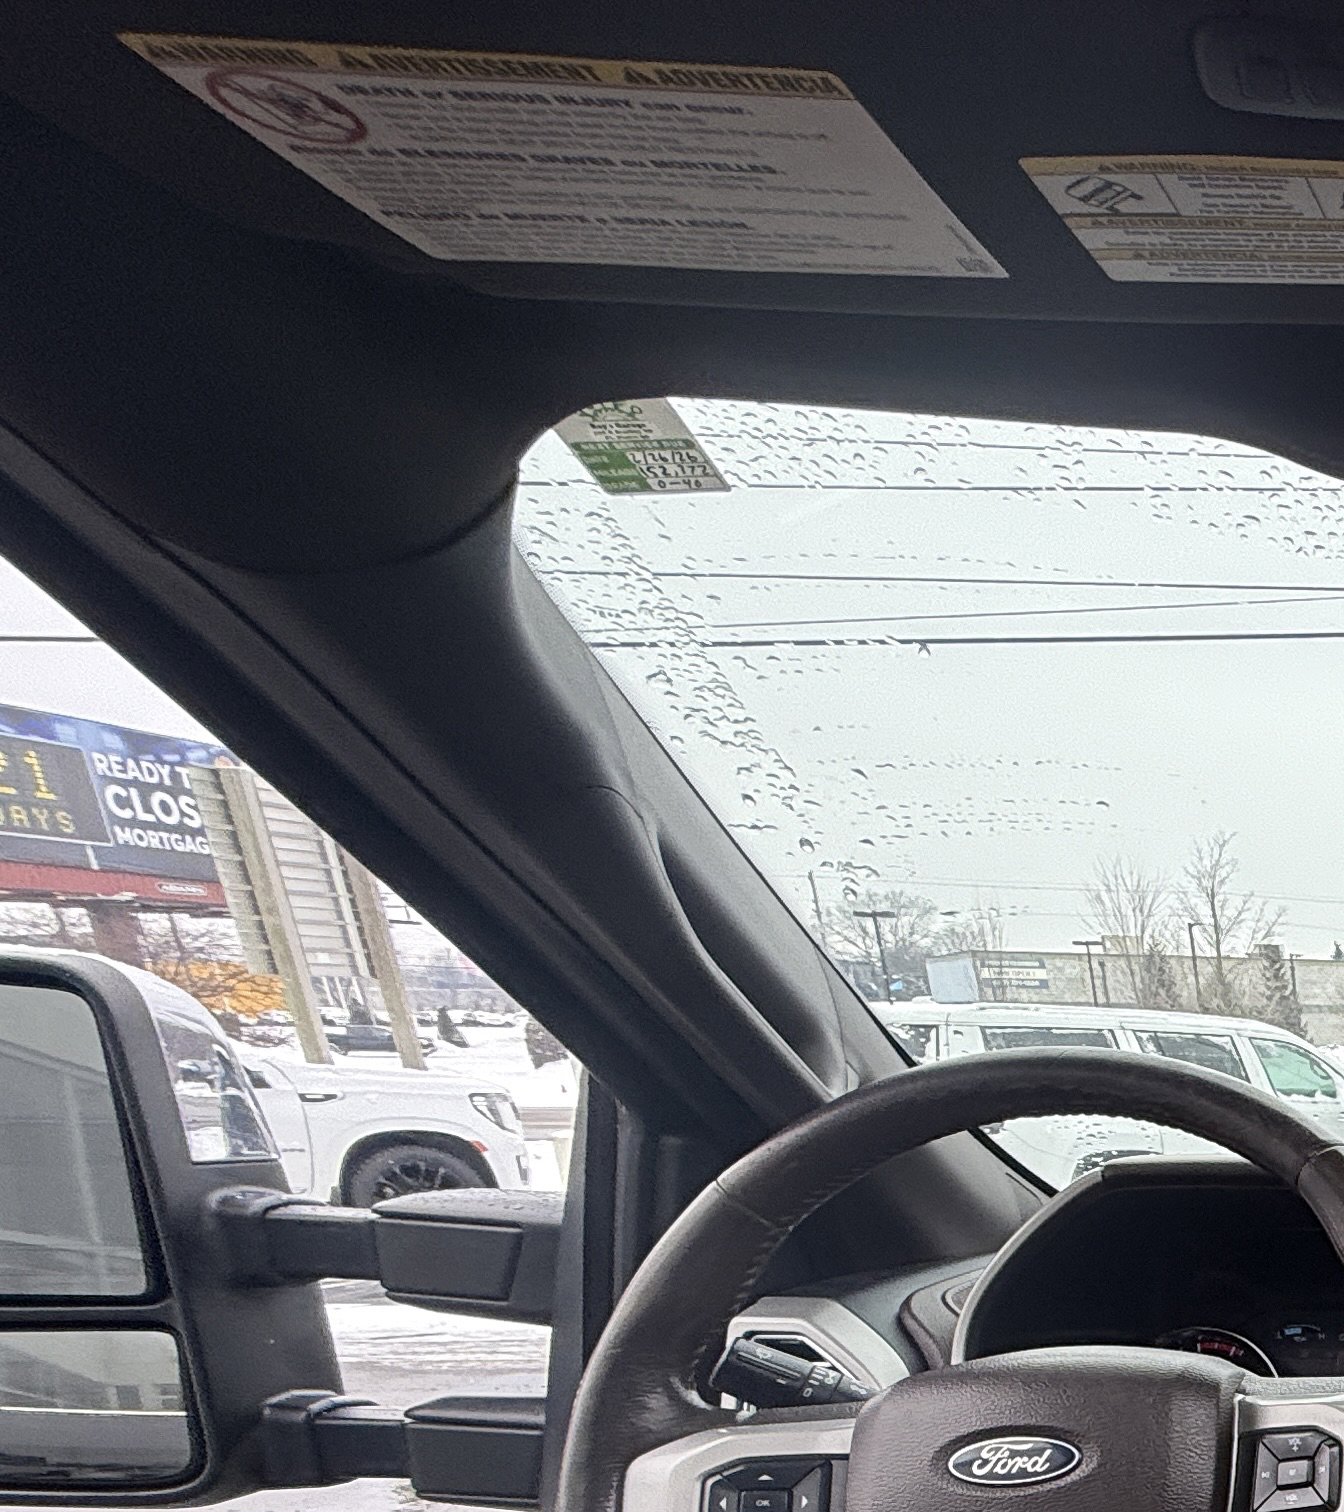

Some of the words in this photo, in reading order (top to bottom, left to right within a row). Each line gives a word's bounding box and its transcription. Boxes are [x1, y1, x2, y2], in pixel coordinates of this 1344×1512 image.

[371, 46, 602, 82] AVERTISSEMENT
[655, 68, 848, 97] ADVERTENCIA
[91, 751, 172, 786] READY
[172, 765, 191, 789] T
[0, 803, 76, 833] AYS
[104, 783, 203, 828] CLOS
[112, 825, 210, 855] MORTGAG
[971, 1442, 1053, 1477] Ford
[755, 1498, 771, 1508] OK
